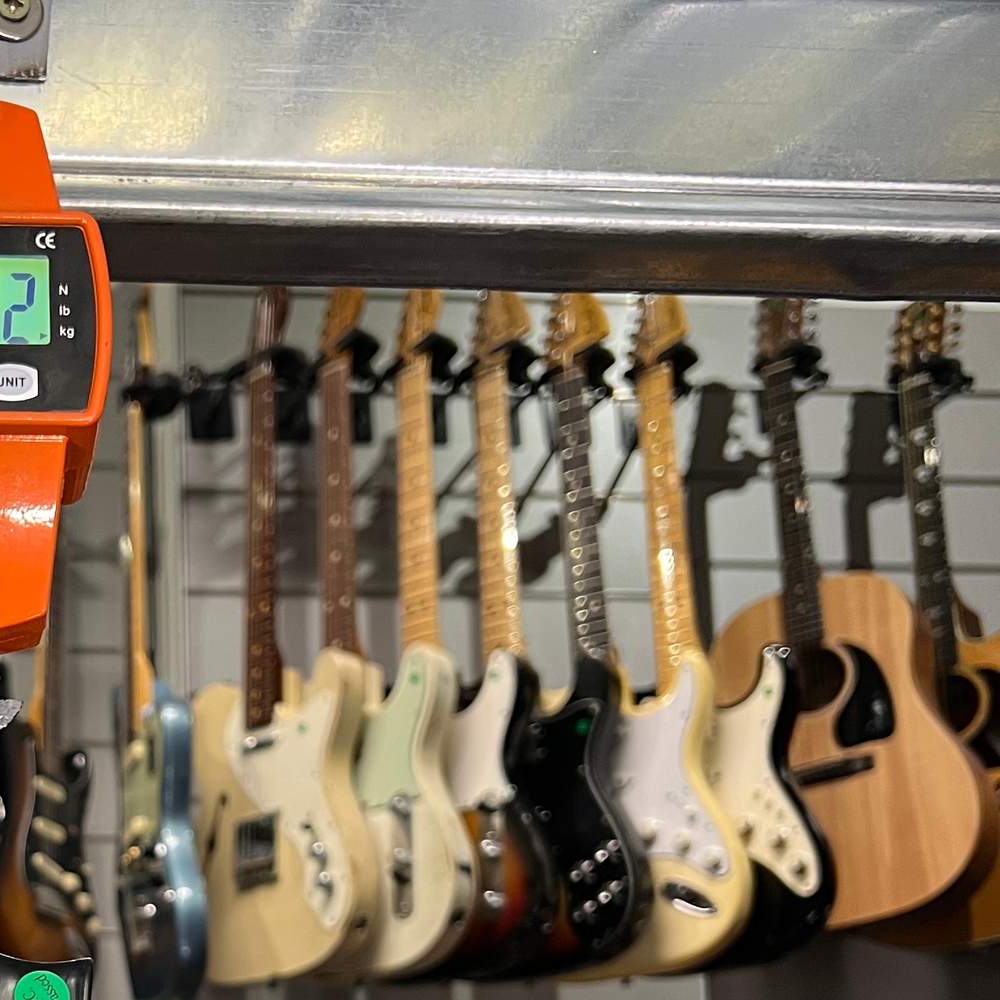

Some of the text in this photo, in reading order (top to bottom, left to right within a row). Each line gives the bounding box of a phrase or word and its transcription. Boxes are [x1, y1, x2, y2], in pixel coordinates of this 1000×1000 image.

[58, 284, 69, 296] N
[59, 304, 71, 317] lb
[59, 325, 75, 339] kg
